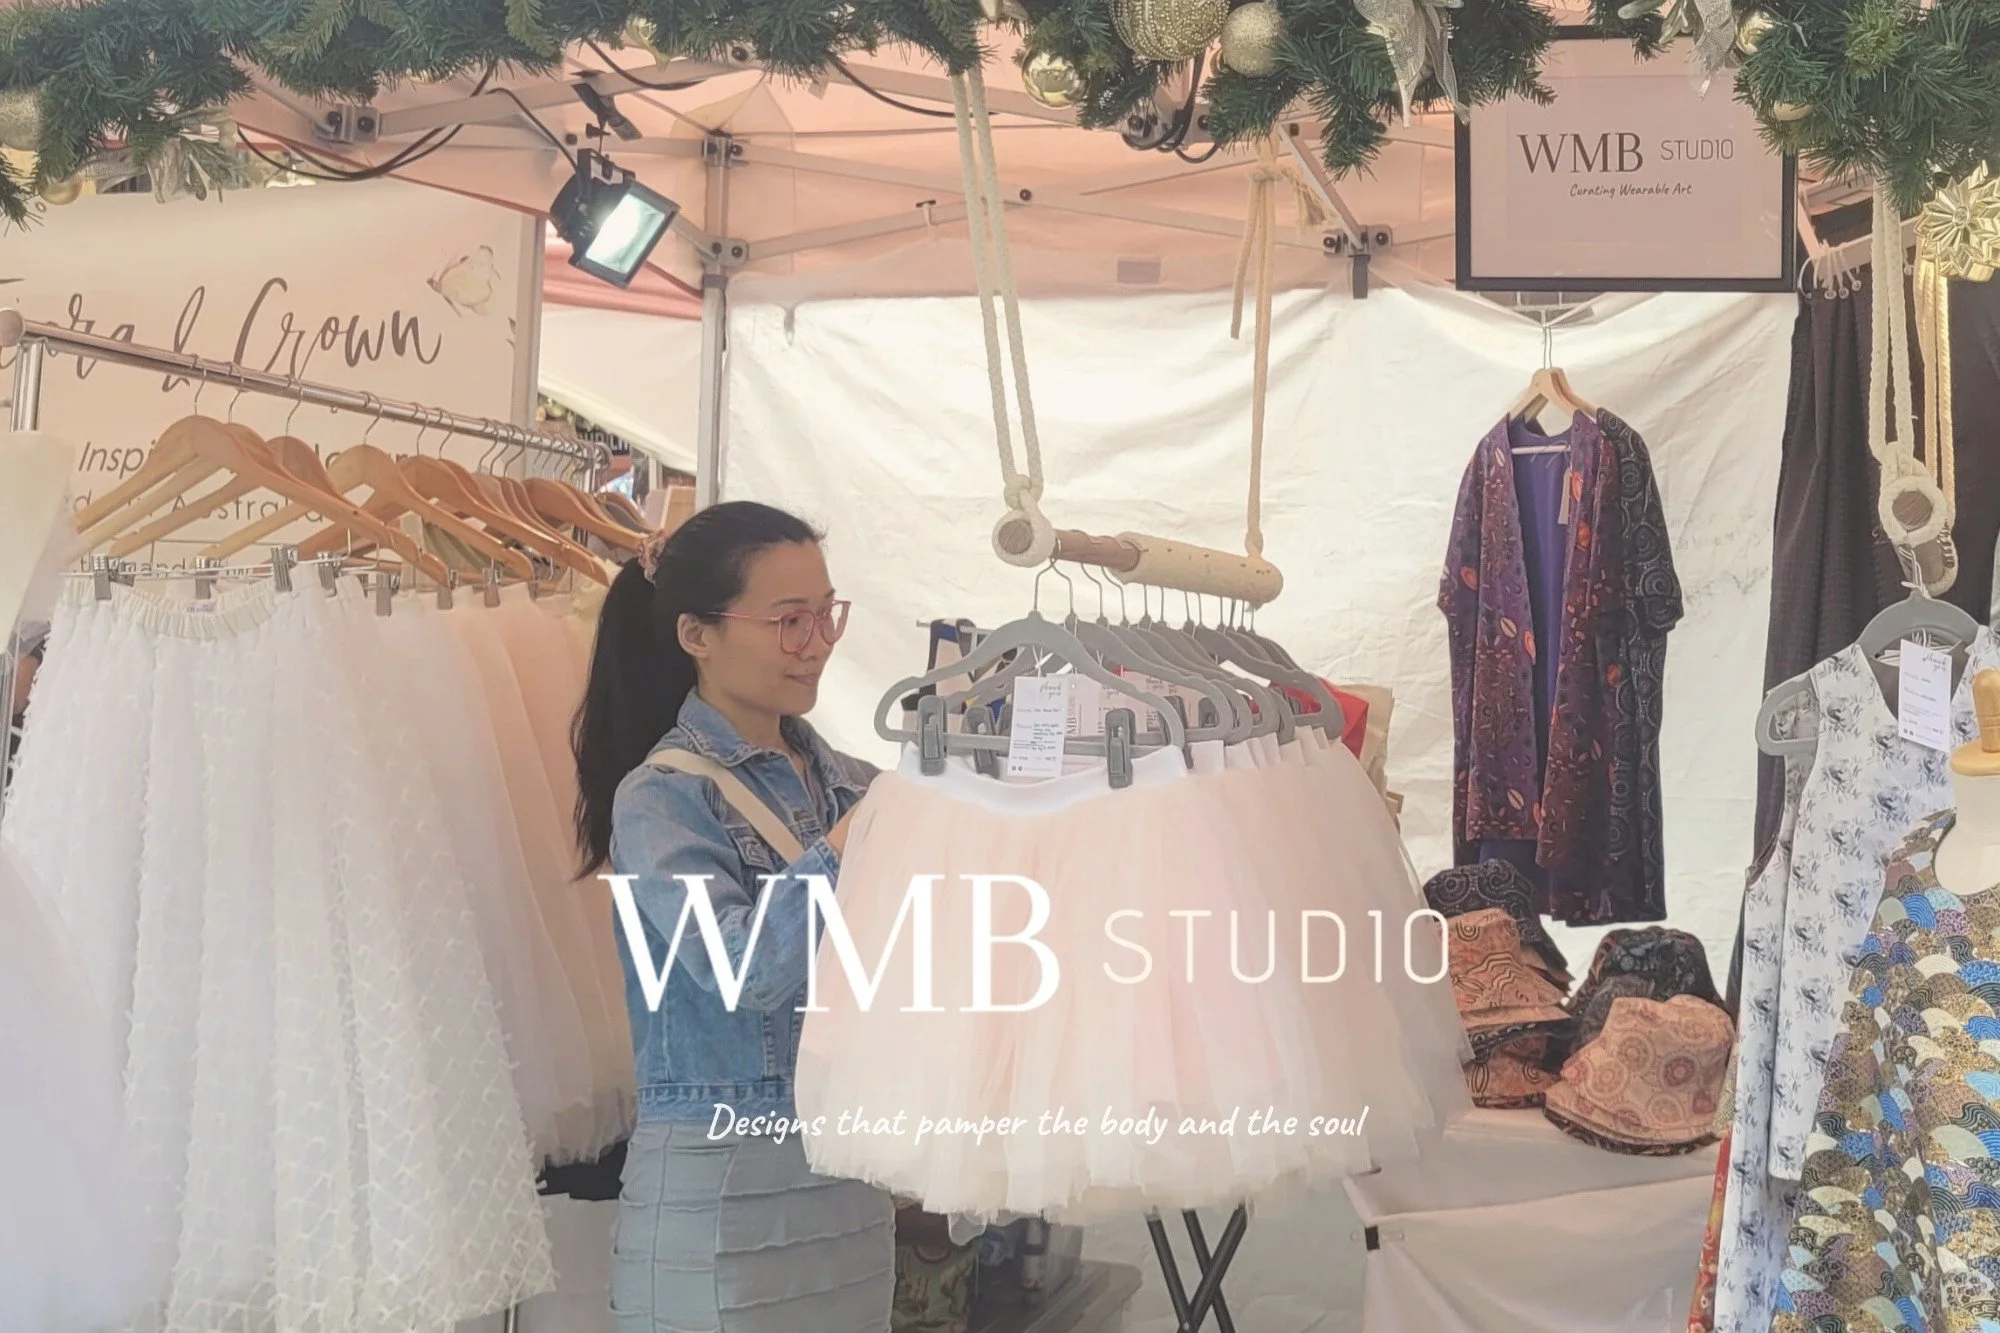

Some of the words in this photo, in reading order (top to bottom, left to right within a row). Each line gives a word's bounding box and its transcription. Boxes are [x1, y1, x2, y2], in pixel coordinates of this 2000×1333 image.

[1516, 132, 1644, 174] WMB
[1660, 138, 1734, 161] STUDIO
[1569, 183, 1616, 199] Curating
[1619, 182, 1670, 196] Wearable
[1672, 182, 1693, 195] Art
[232, 277, 442, 381] Crown
[1066, 716, 1078, 735] MB
